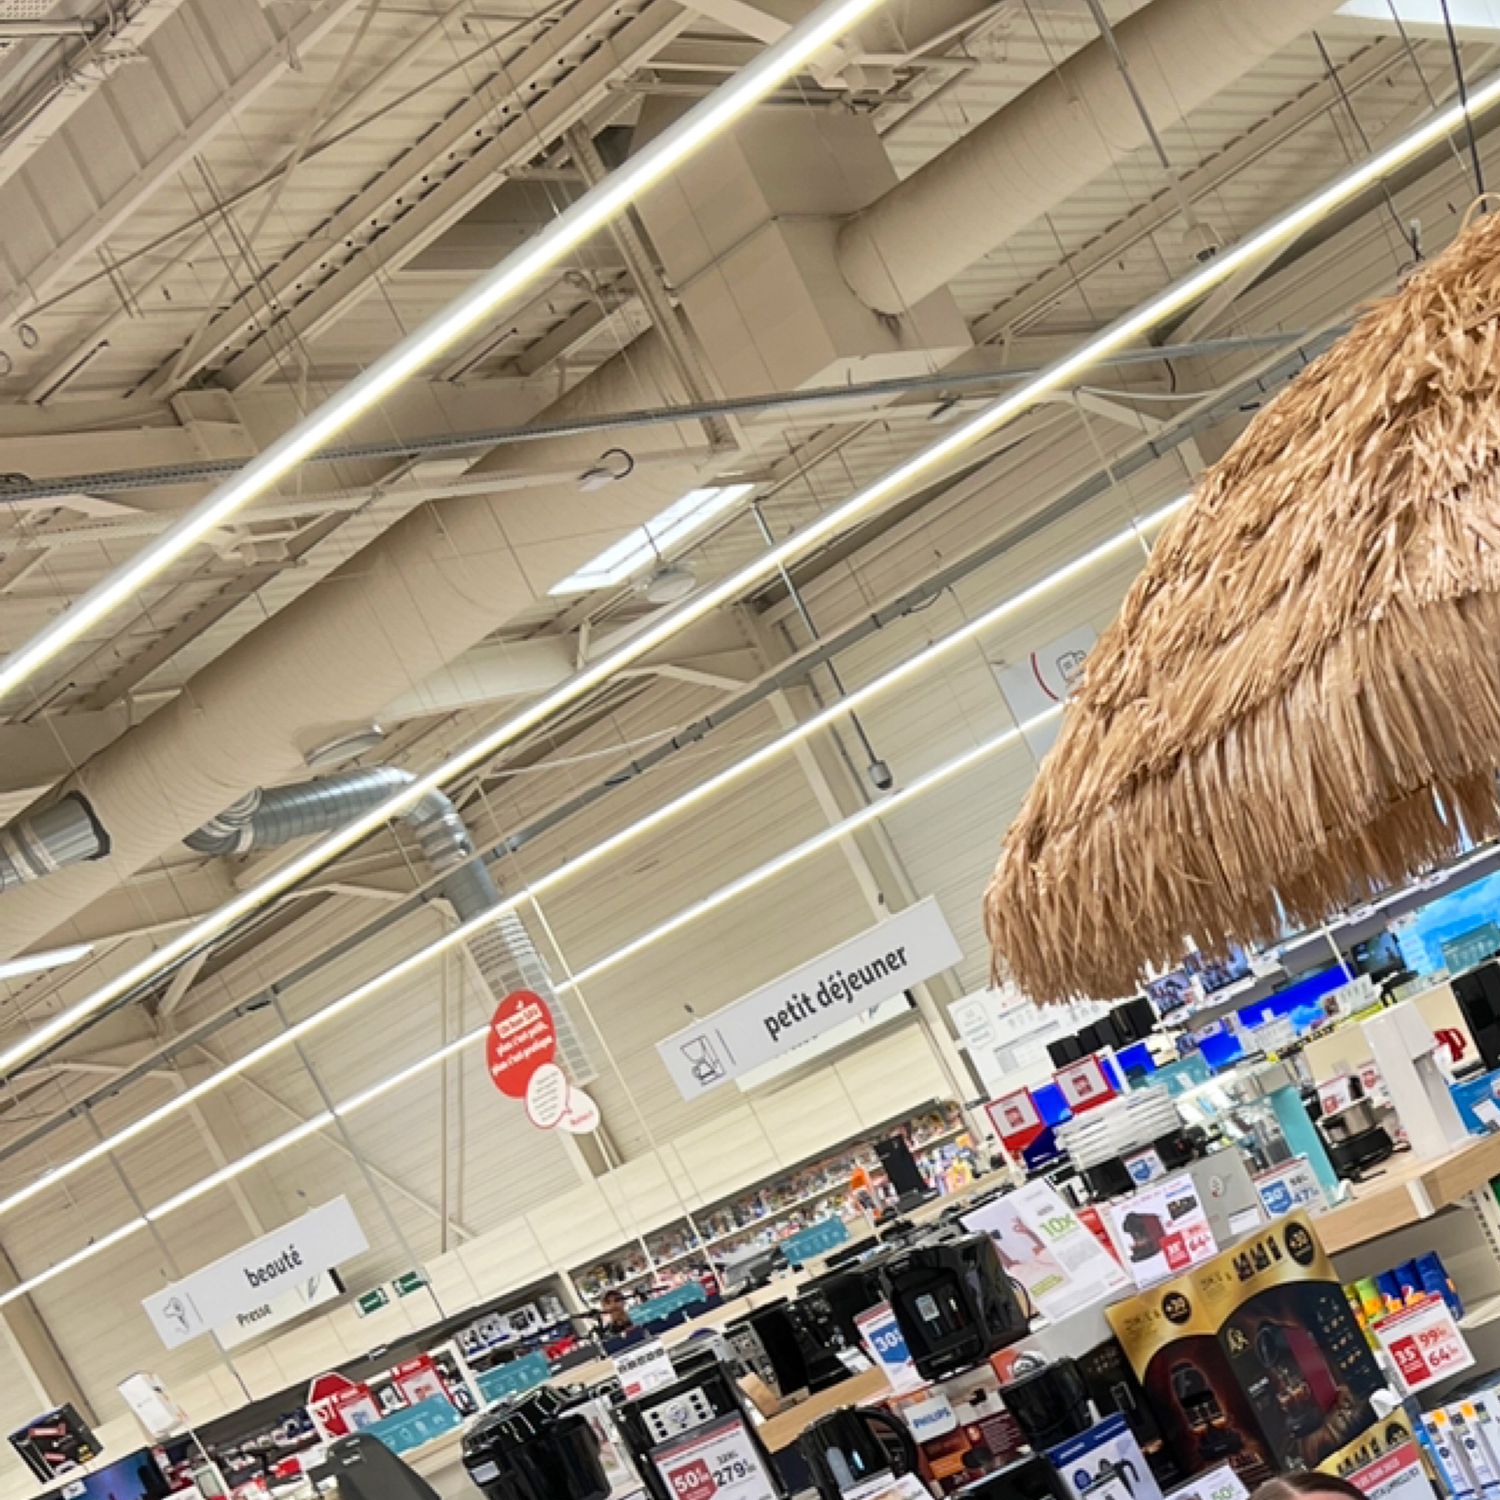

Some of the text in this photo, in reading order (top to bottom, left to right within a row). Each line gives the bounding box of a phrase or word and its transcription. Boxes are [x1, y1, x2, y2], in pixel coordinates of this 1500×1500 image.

[763, 945, 907, 1041] petit déjeuner
[243, 1244, 303, 1288] beauté
[236, 1304, 273, 1327] Presse
[912, 1407, 951, 1429] PHILIPS
